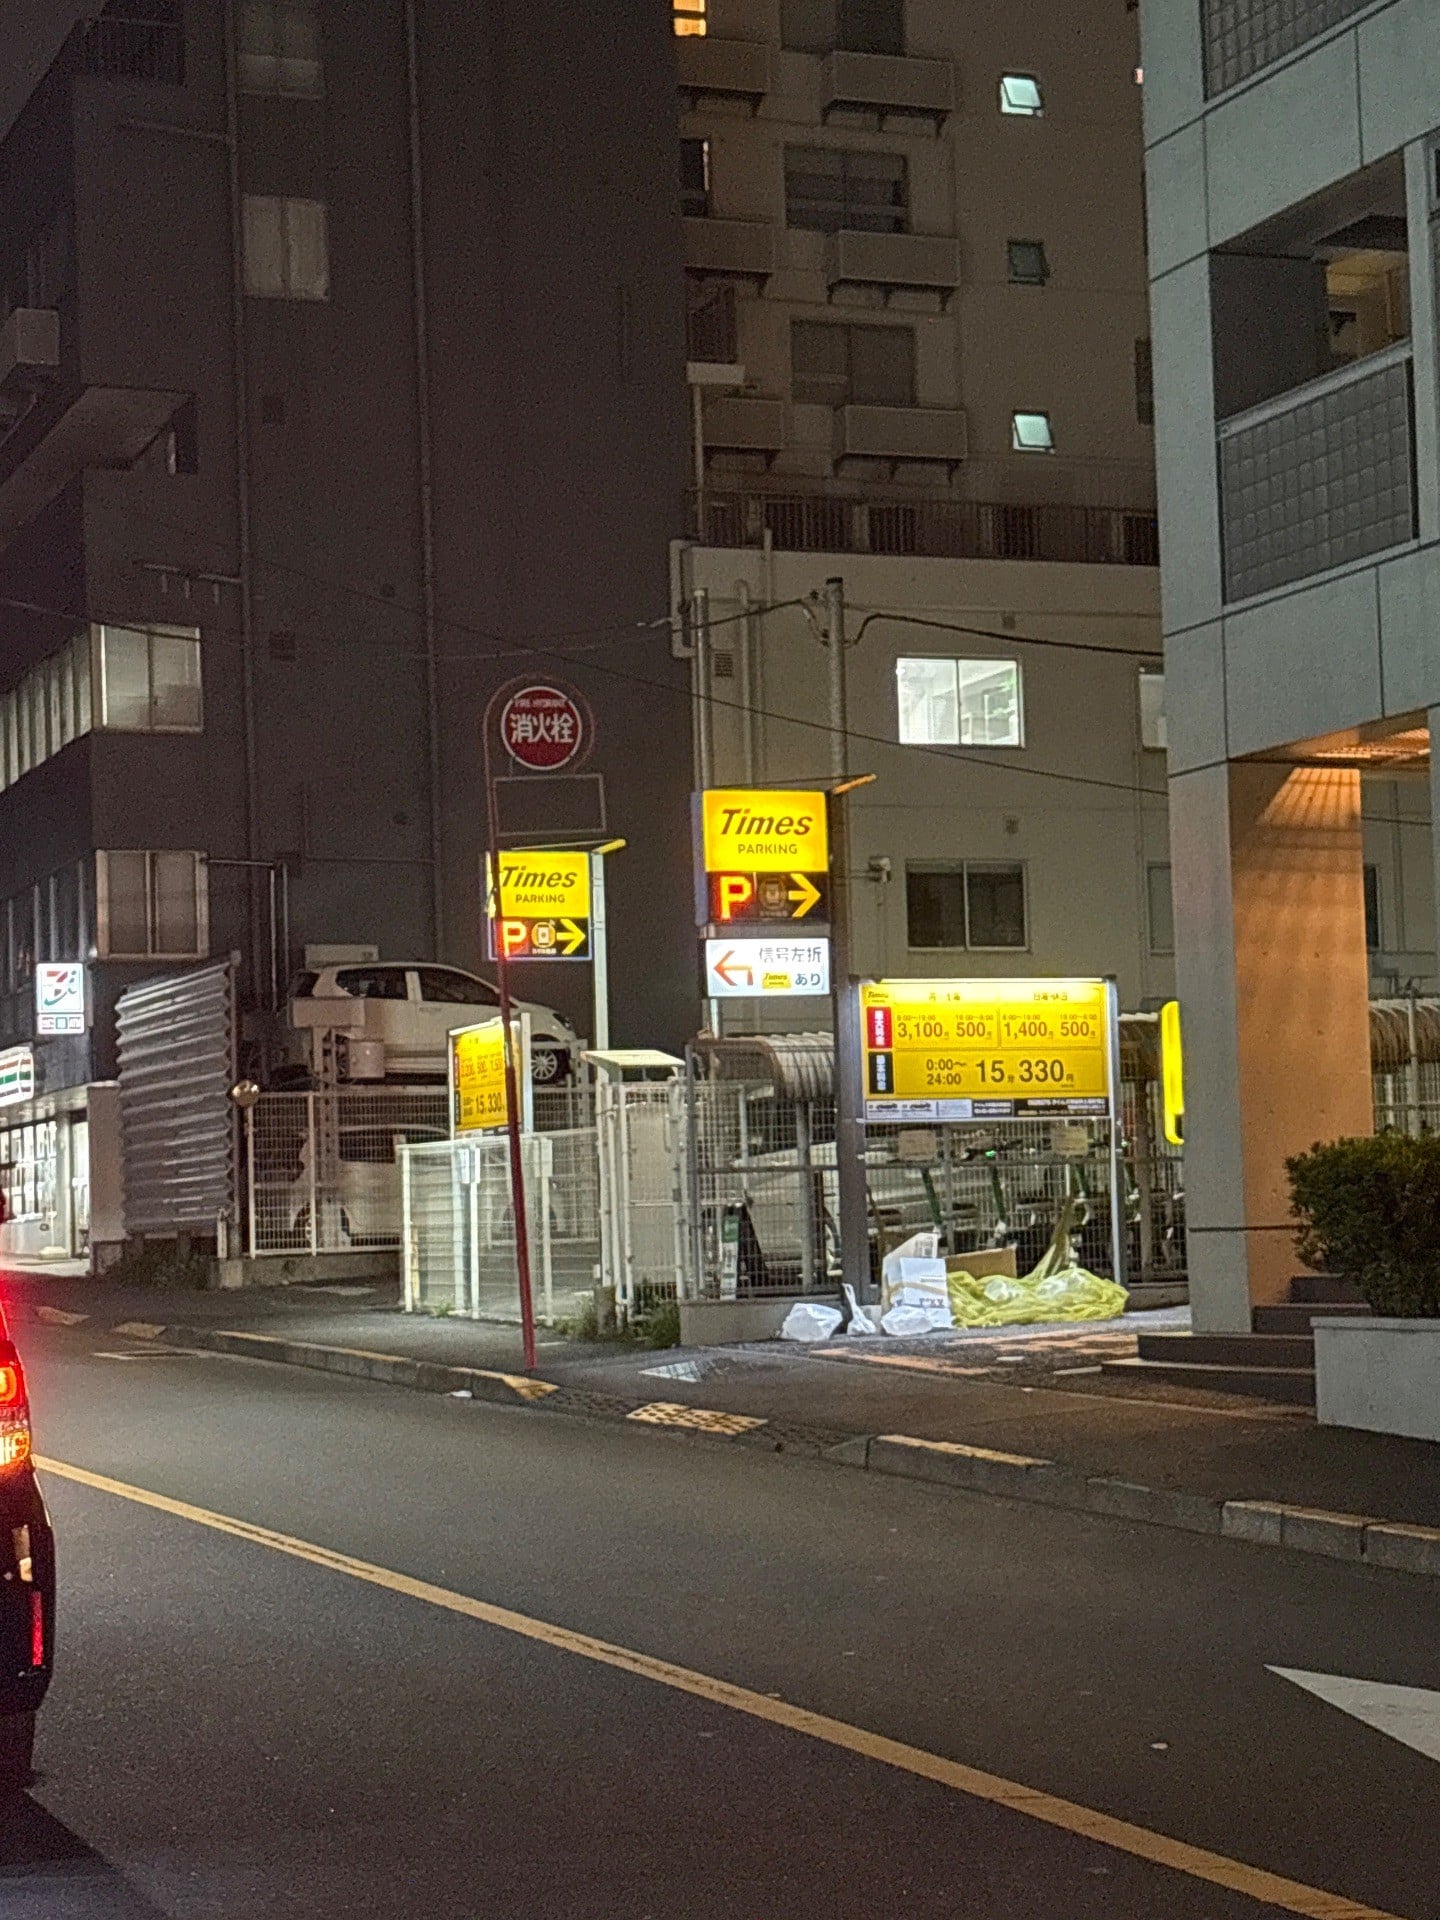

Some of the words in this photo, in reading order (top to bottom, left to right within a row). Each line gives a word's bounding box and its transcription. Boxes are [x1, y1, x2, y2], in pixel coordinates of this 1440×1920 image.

[509, 711, 574, 743] 消火栓
[720, 808, 813, 836] Times
[738, 843, 798, 855] PARKING
[502, 865, 578, 888] Times
[515, 894, 566, 904] PARKING
[720, 876, 752, 920] P
[502, 920, 528, 958] P
[759, 946, 822, 963] 信号左折
[795, 973, 821, 986] あり
[926, 1073, 962, 1086] 24:00
